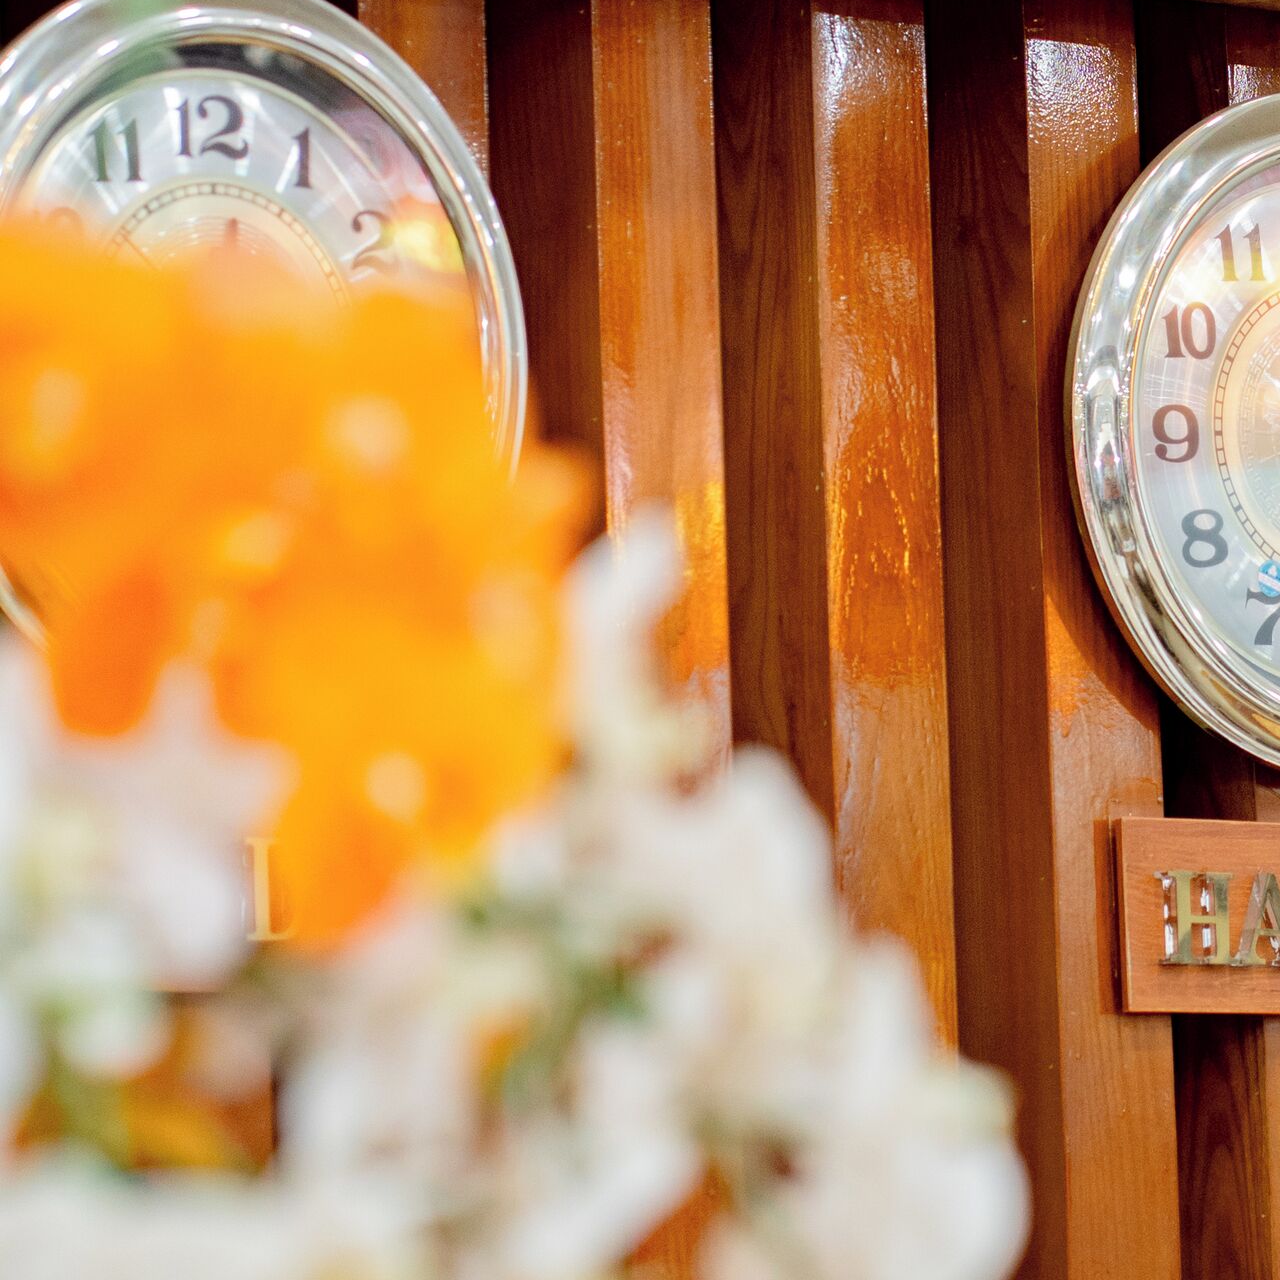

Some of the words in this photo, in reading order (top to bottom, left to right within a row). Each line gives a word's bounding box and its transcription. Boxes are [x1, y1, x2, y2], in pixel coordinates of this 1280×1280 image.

[89, 118, 143, 183] 11
[175, 95, 248, 159] 12
[292, 126, 313, 190] 1
[1215, 222, 1267, 282] 11
[1163, 301, 1215, 359] 10
[1152, 405, 1199, 464] 9
[1181, 508, 1228, 568] 8
